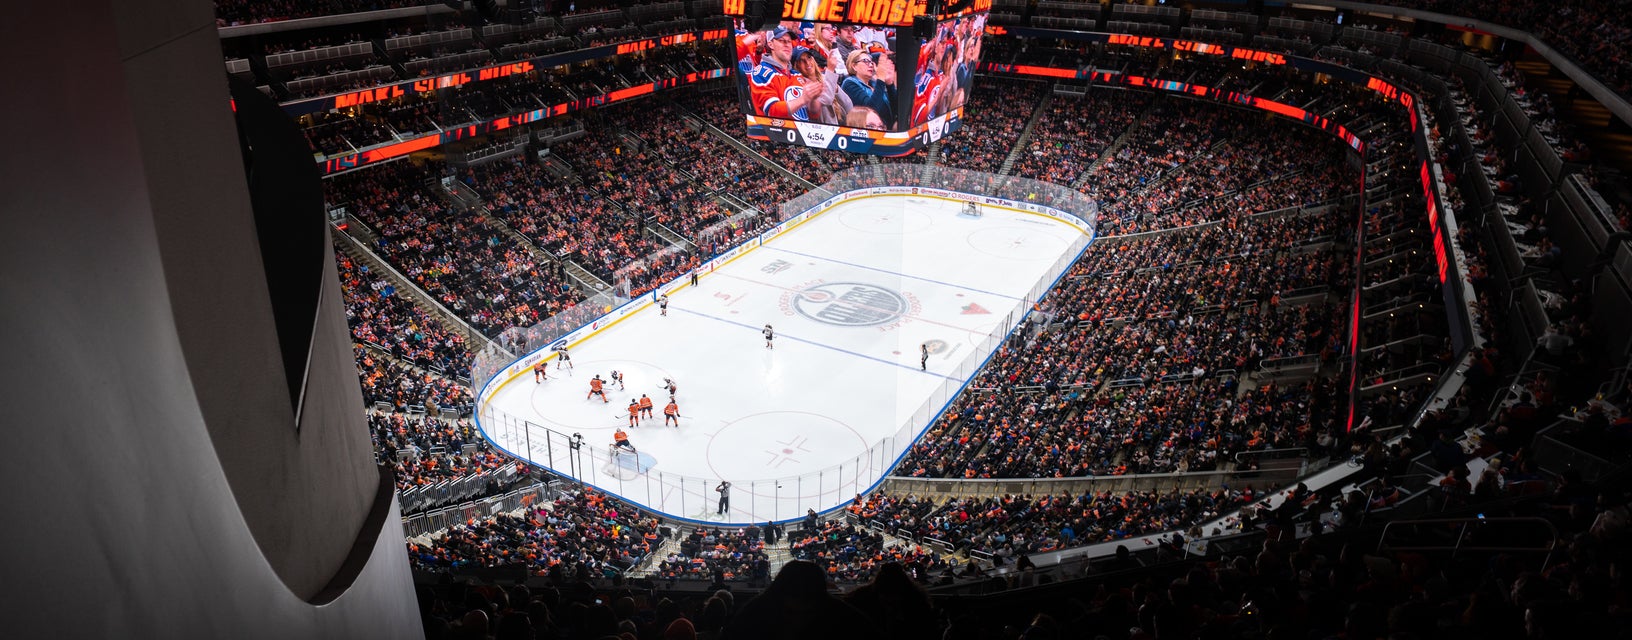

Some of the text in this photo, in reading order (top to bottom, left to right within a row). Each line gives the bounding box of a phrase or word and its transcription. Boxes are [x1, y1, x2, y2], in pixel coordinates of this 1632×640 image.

[787, 129, 796, 142] 0
[807, 132, 825, 142] 4:54
[838, 136, 848, 149] 0
[957, 193, 981, 202] ROGERS
